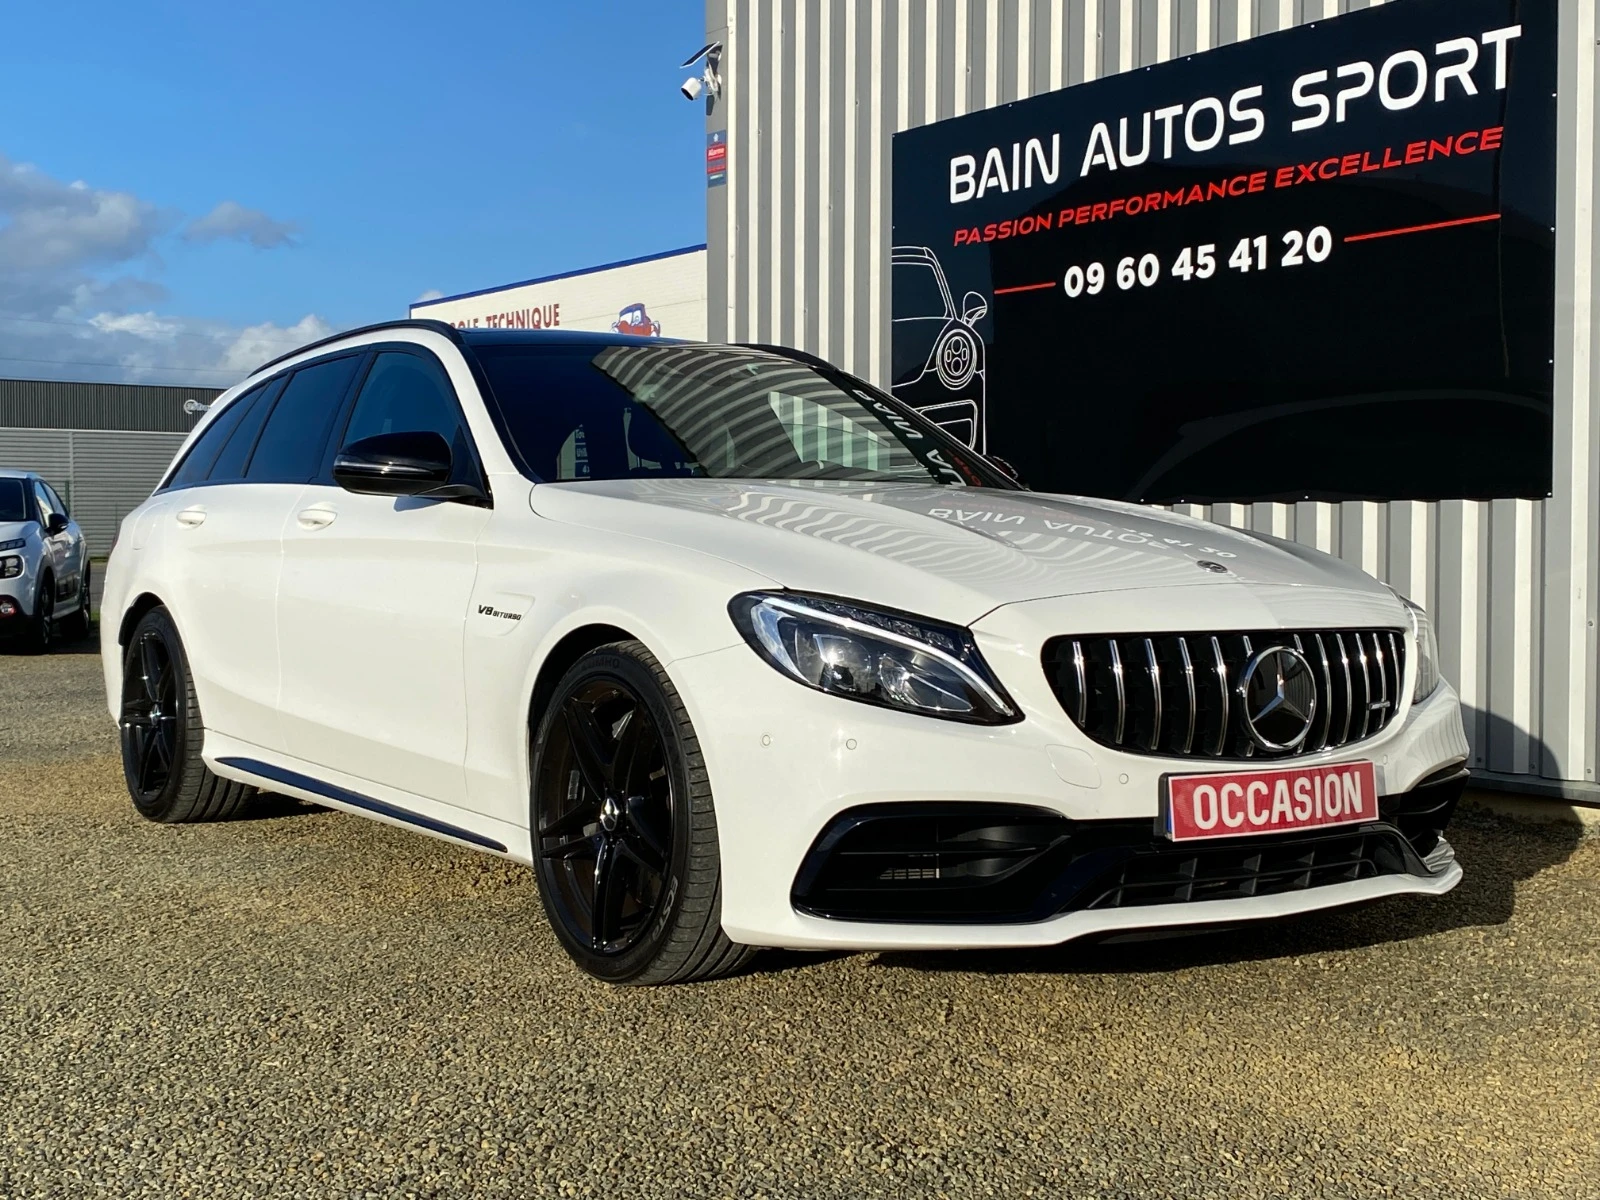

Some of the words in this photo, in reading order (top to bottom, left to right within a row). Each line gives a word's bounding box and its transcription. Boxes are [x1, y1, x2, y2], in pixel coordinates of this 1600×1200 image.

[949, 133, 1060, 204] BAIN
[1079, 84, 1266, 177] AUTOS
[1291, 24, 1523, 133] SPORT
[953, 212, 1053, 247] PASSION
[1057, 171, 1267, 228] PERFORMANCE
[1274, 126, 1505, 189] EXCELLENCE
[1063, 261, 1106, 299] 09
[1115, 253, 1160, 288] 60
[1170, 243, 1217, 282] 45
[1227, 234, 1268, 274] 41
[1280, 225, 1333, 267] 20
[486, 303, 560, 329] TECHNIQUE
[477, 604, 494, 616] V8
[1192, 770, 1364, 830] OCCASION
